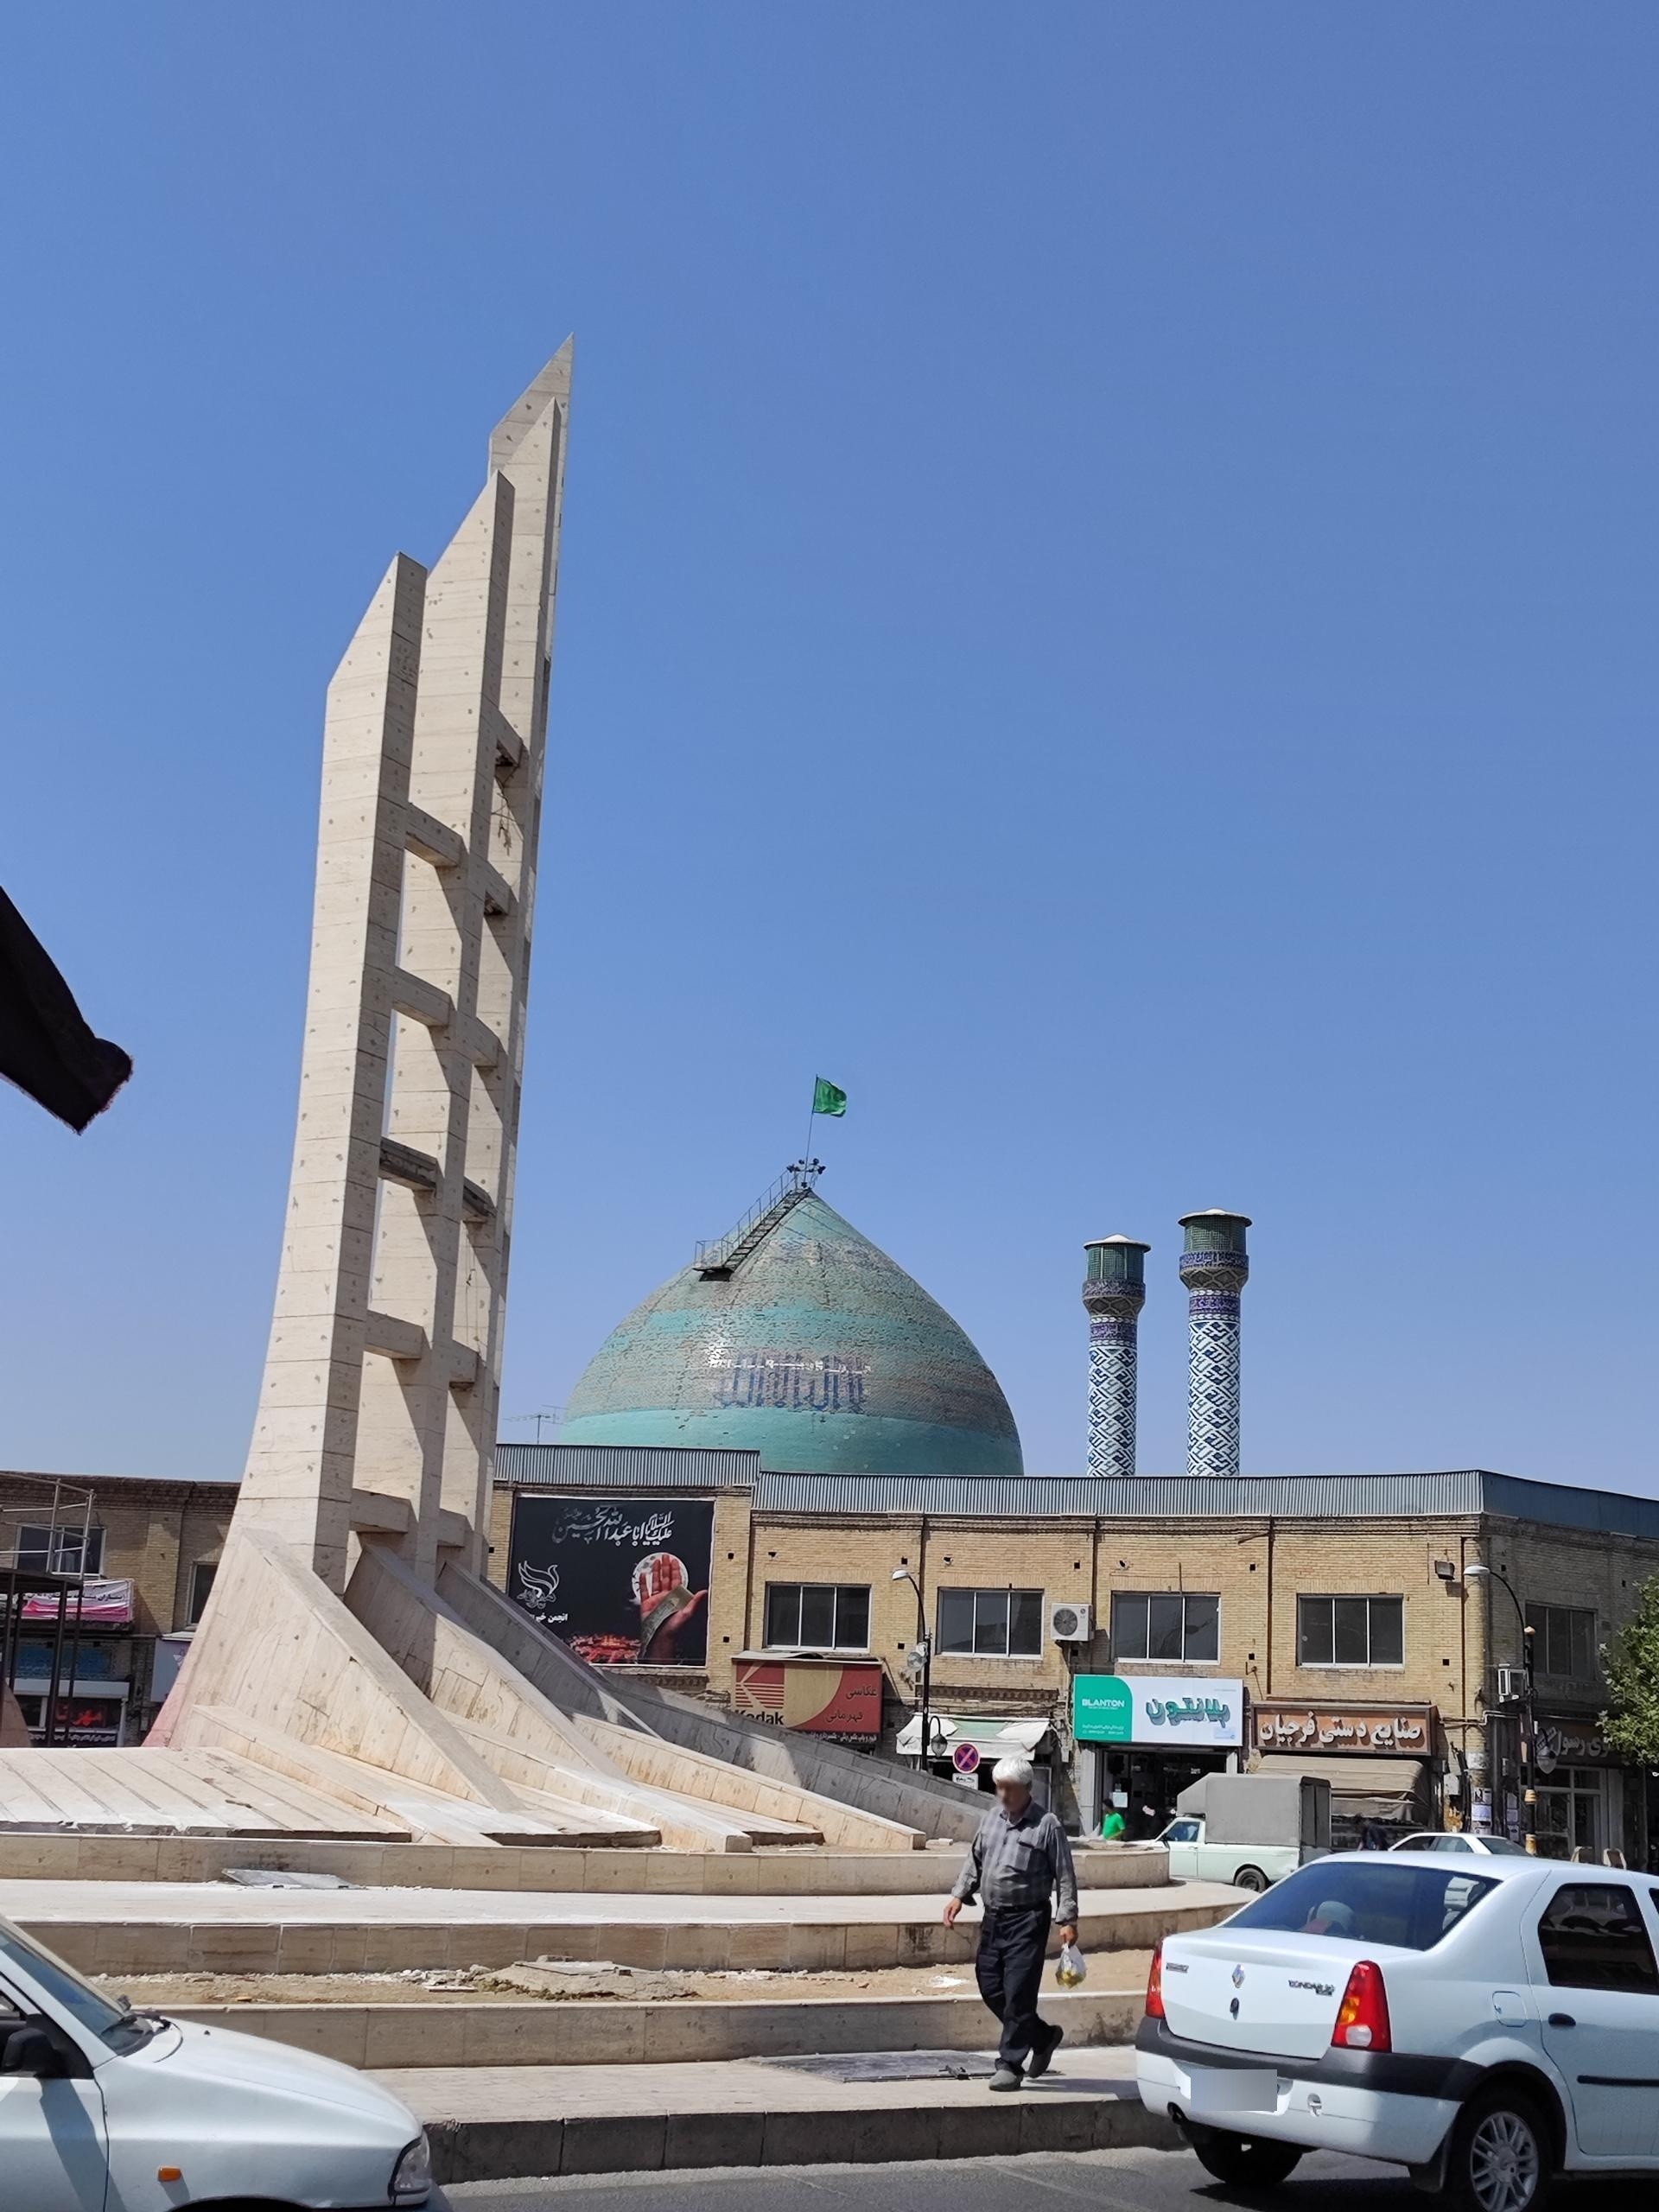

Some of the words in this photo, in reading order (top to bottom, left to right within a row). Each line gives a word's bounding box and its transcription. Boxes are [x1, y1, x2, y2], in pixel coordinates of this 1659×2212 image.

[531, 1611, 547, 1623] خیر
[846, 1684, 878, 1700] عکاسی
[1082, 1698, 1125, 1707] BLANTON
[825, 1708, 864, 1724] قهرمانی
[1260, 1711, 1316, 1744] فرجیان
[1319, 1716, 1367, 1743] دستی
[1370, 1716, 1421, 1745] صنایع
